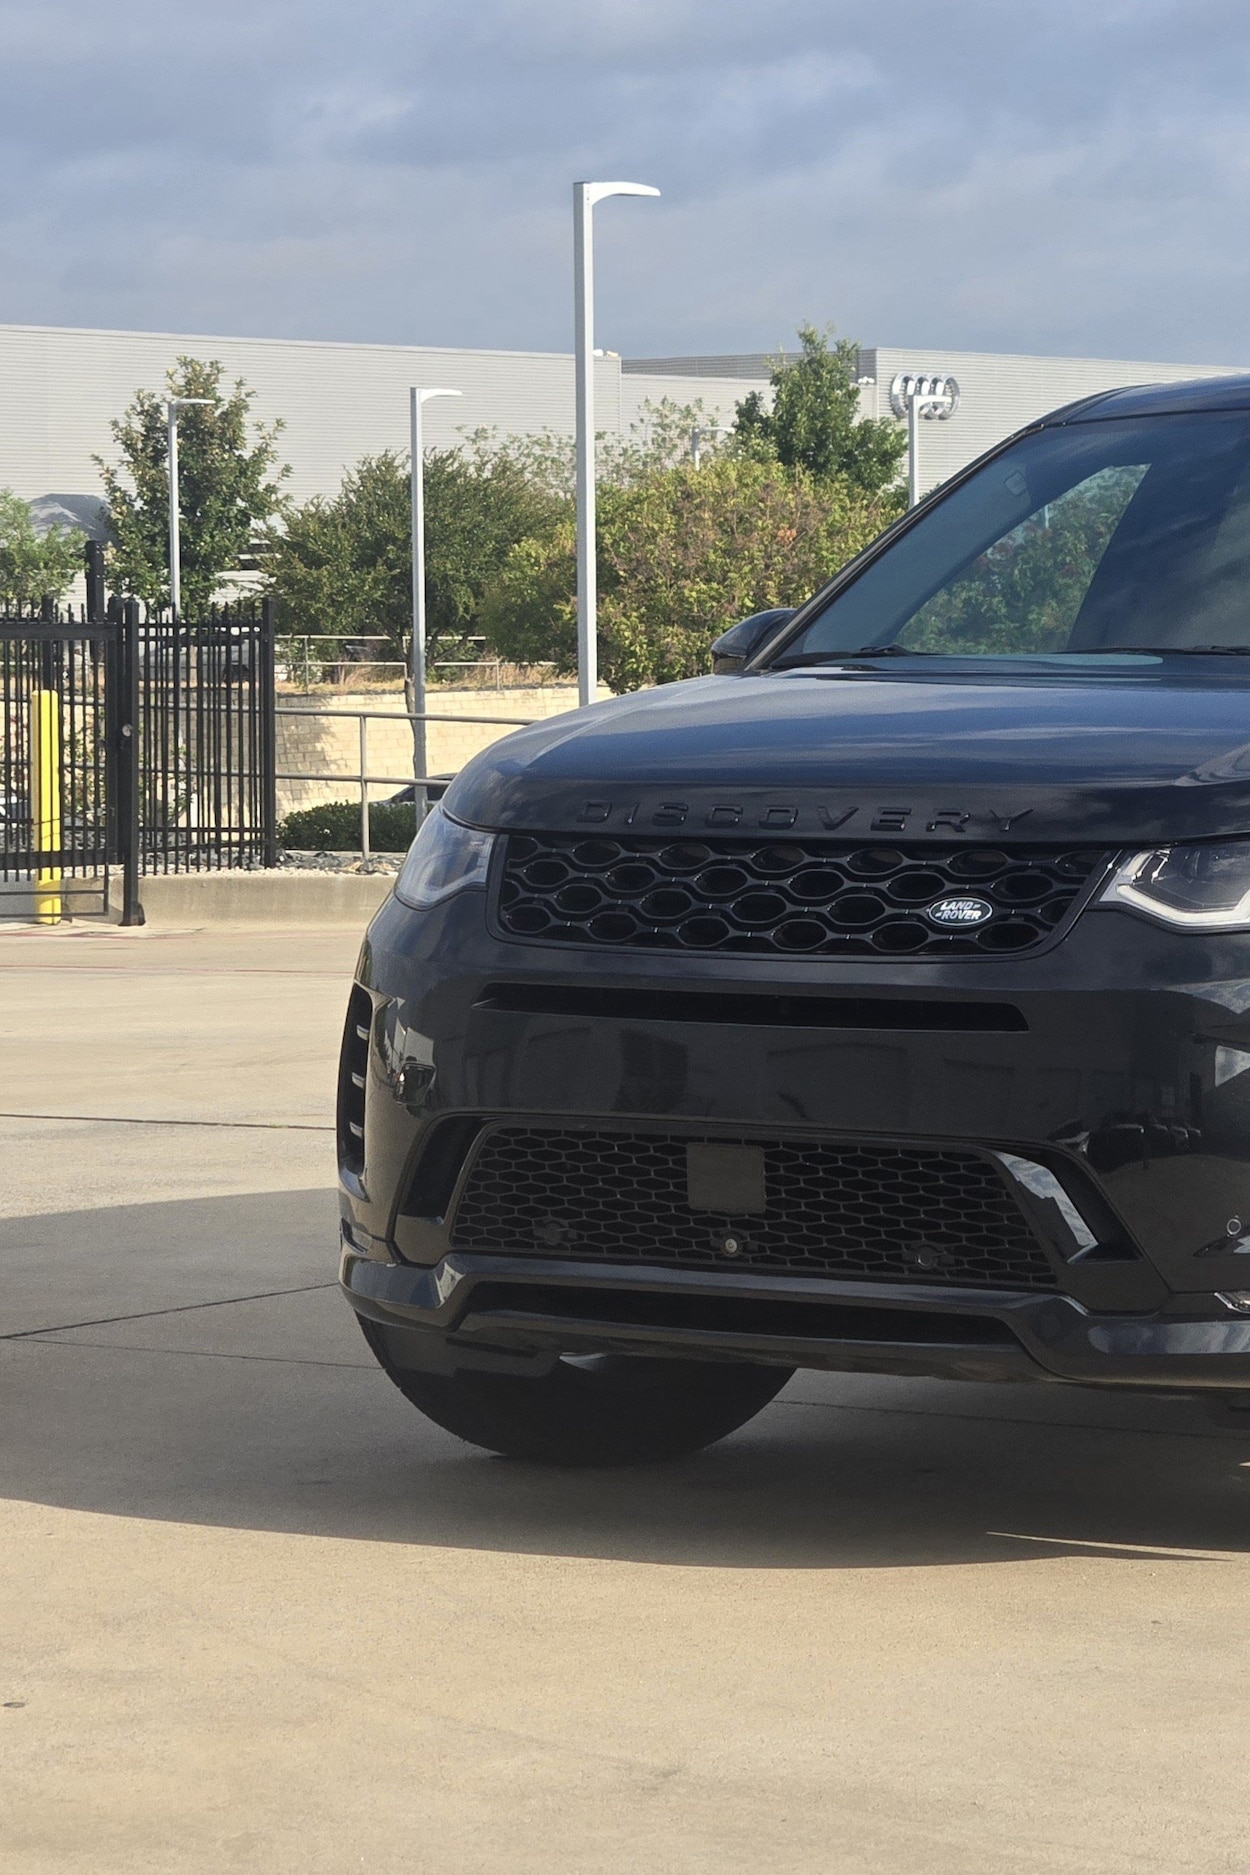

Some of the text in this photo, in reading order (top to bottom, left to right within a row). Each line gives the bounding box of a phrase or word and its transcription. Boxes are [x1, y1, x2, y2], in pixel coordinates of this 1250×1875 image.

[575, 801, 1034, 833] DISCOVERY
[940, 901, 974, 910] LAND
[941, 910, 982, 920] ROVER
